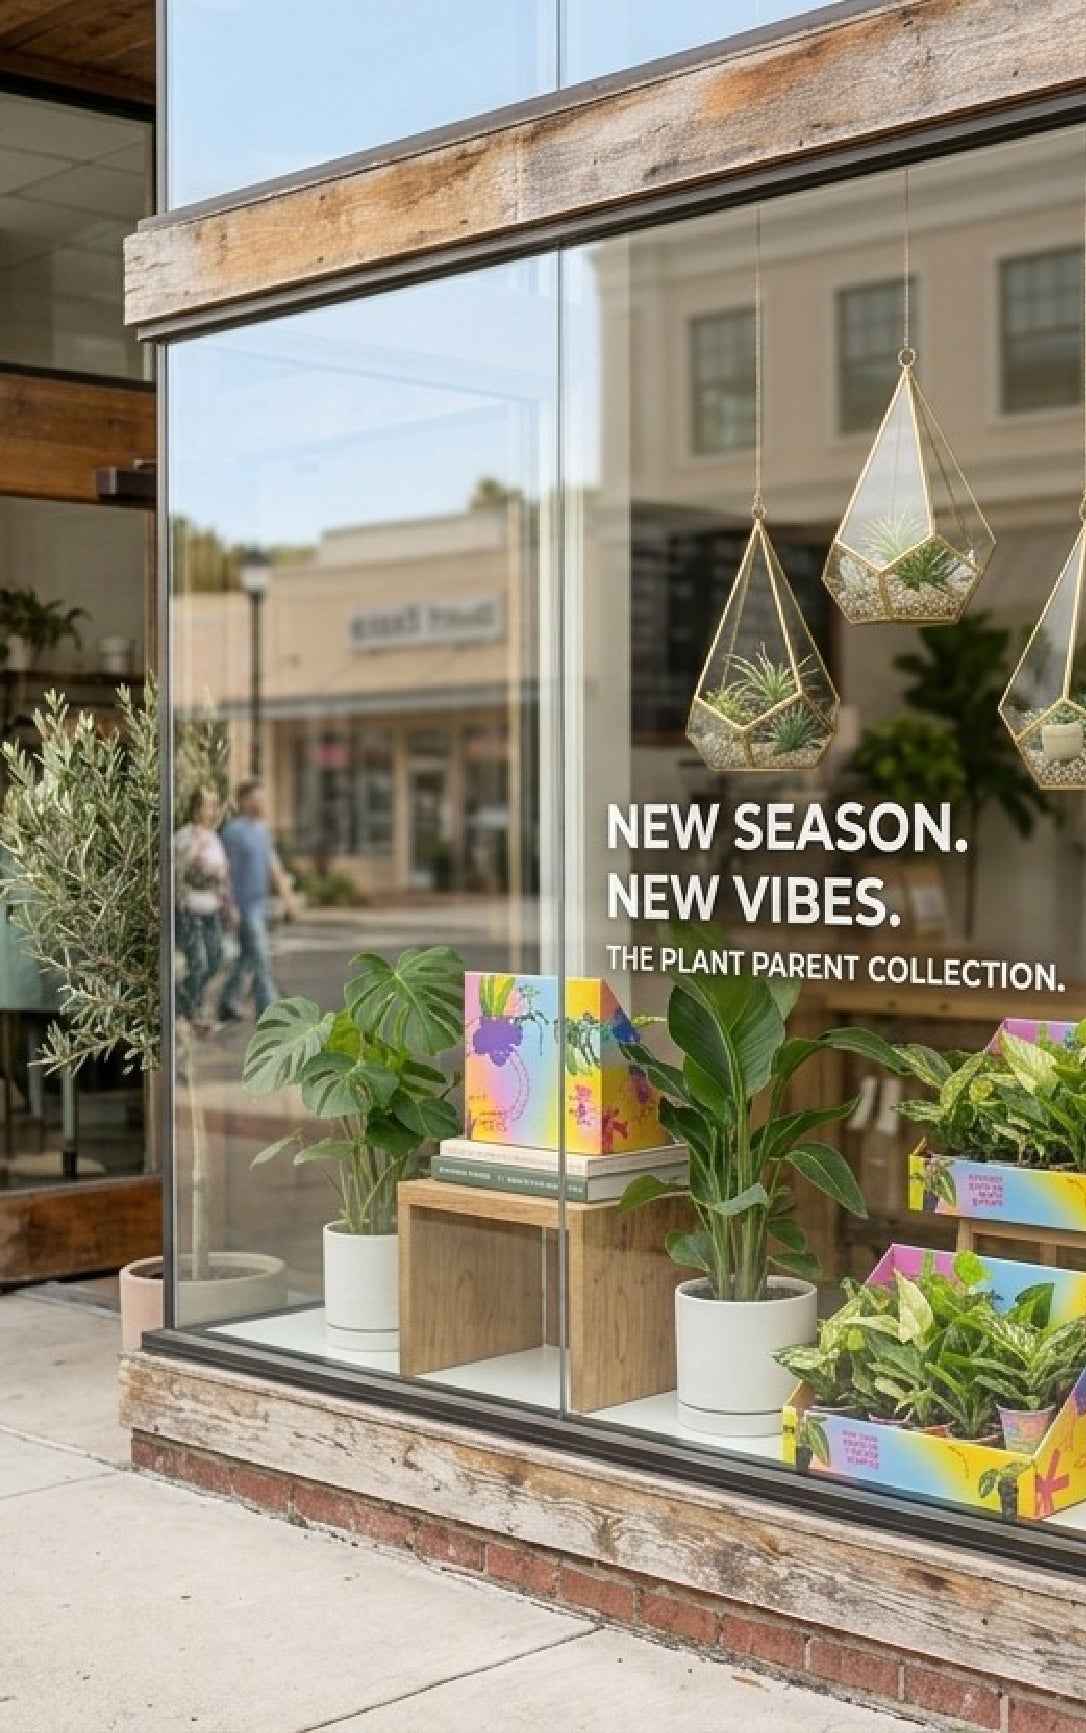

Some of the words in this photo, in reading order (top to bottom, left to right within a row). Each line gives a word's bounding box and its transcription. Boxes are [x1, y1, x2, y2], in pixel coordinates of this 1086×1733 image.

[607, 803, 720, 849] NEW
[734, 803, 968, 853] SEASON.
[607, 872, 720, 920] NEW
[732, 876, 901, 927] VIBES.
[606, 945, 654, 972] THE
[662, 947, 745, 976] PLANT
[752, 951, 860, 981] PARENT
[868, 955, 1066, 992] COLLECTION.
